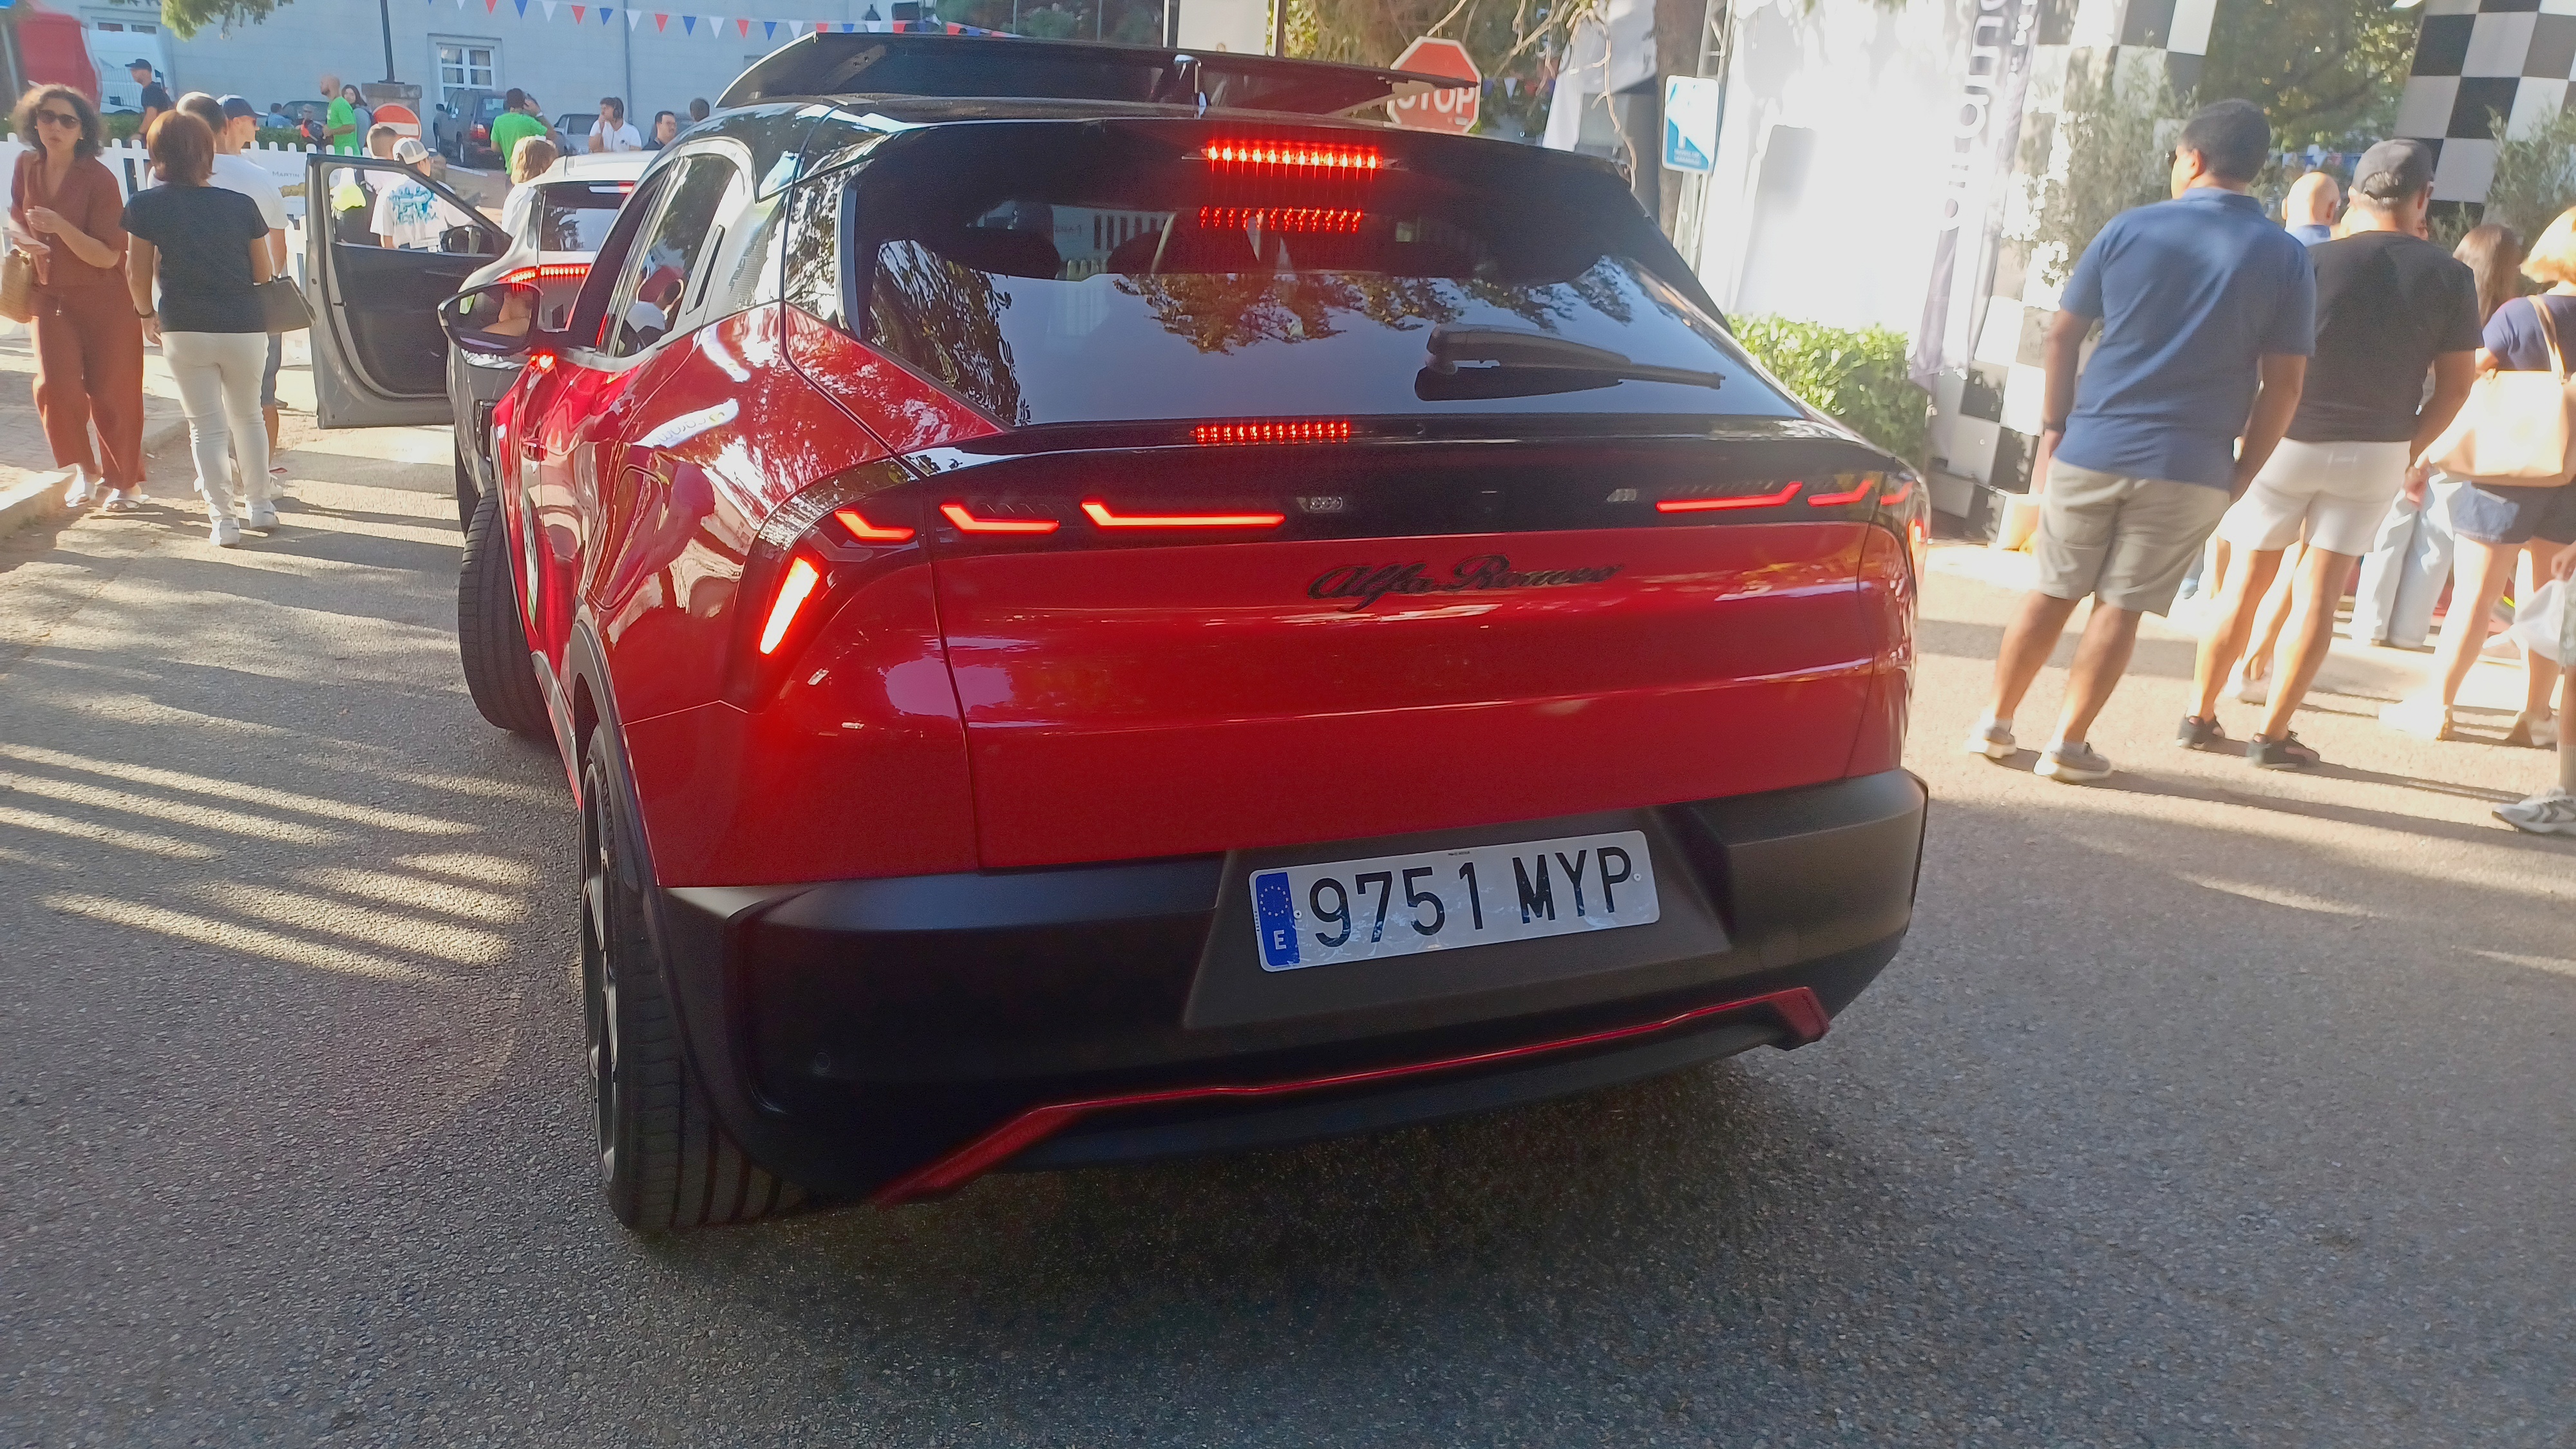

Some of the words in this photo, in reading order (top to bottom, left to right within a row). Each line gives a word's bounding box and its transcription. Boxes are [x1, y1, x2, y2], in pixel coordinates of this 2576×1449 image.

[1307, 562, 1435, 613] Alfa
[1453, 554, 1625, 591] Romeo
[1309, 862, 1484, 948] 9751
[1513, 846, 1633, 925] MYP
[1273, 929, 1287, 950] E
